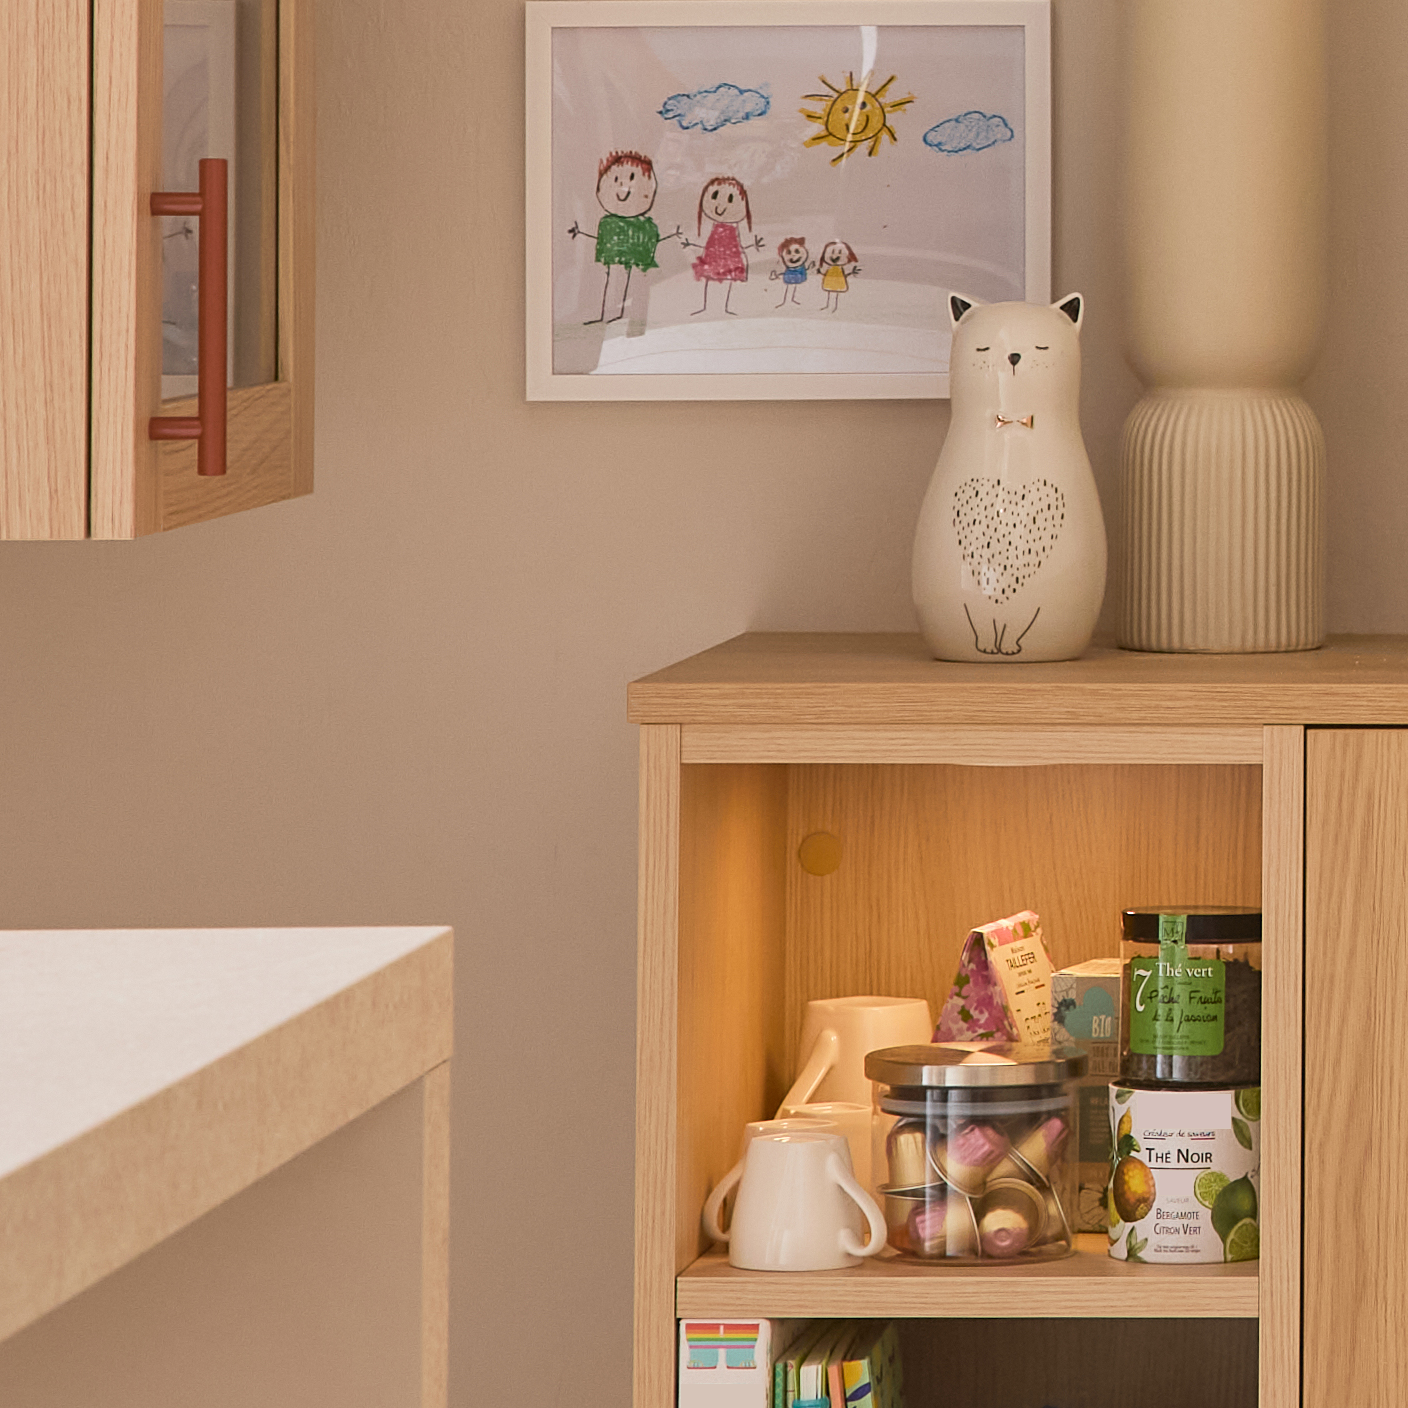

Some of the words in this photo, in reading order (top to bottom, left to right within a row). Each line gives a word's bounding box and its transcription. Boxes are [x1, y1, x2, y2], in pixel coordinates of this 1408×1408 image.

[1155, 962, 1182, 977] Thé
[1185, 966, 1214, 977] vert
[1133, 967, 1153, 1012] 7
[1177, 1148, 1213, 1163] NOIR
[1156, 1207, 1200, 1220] BERGAMOTE
[1154, 1223, 1180, 1235] CITRON
[1182, 1223, 1201, 1235] VERT
